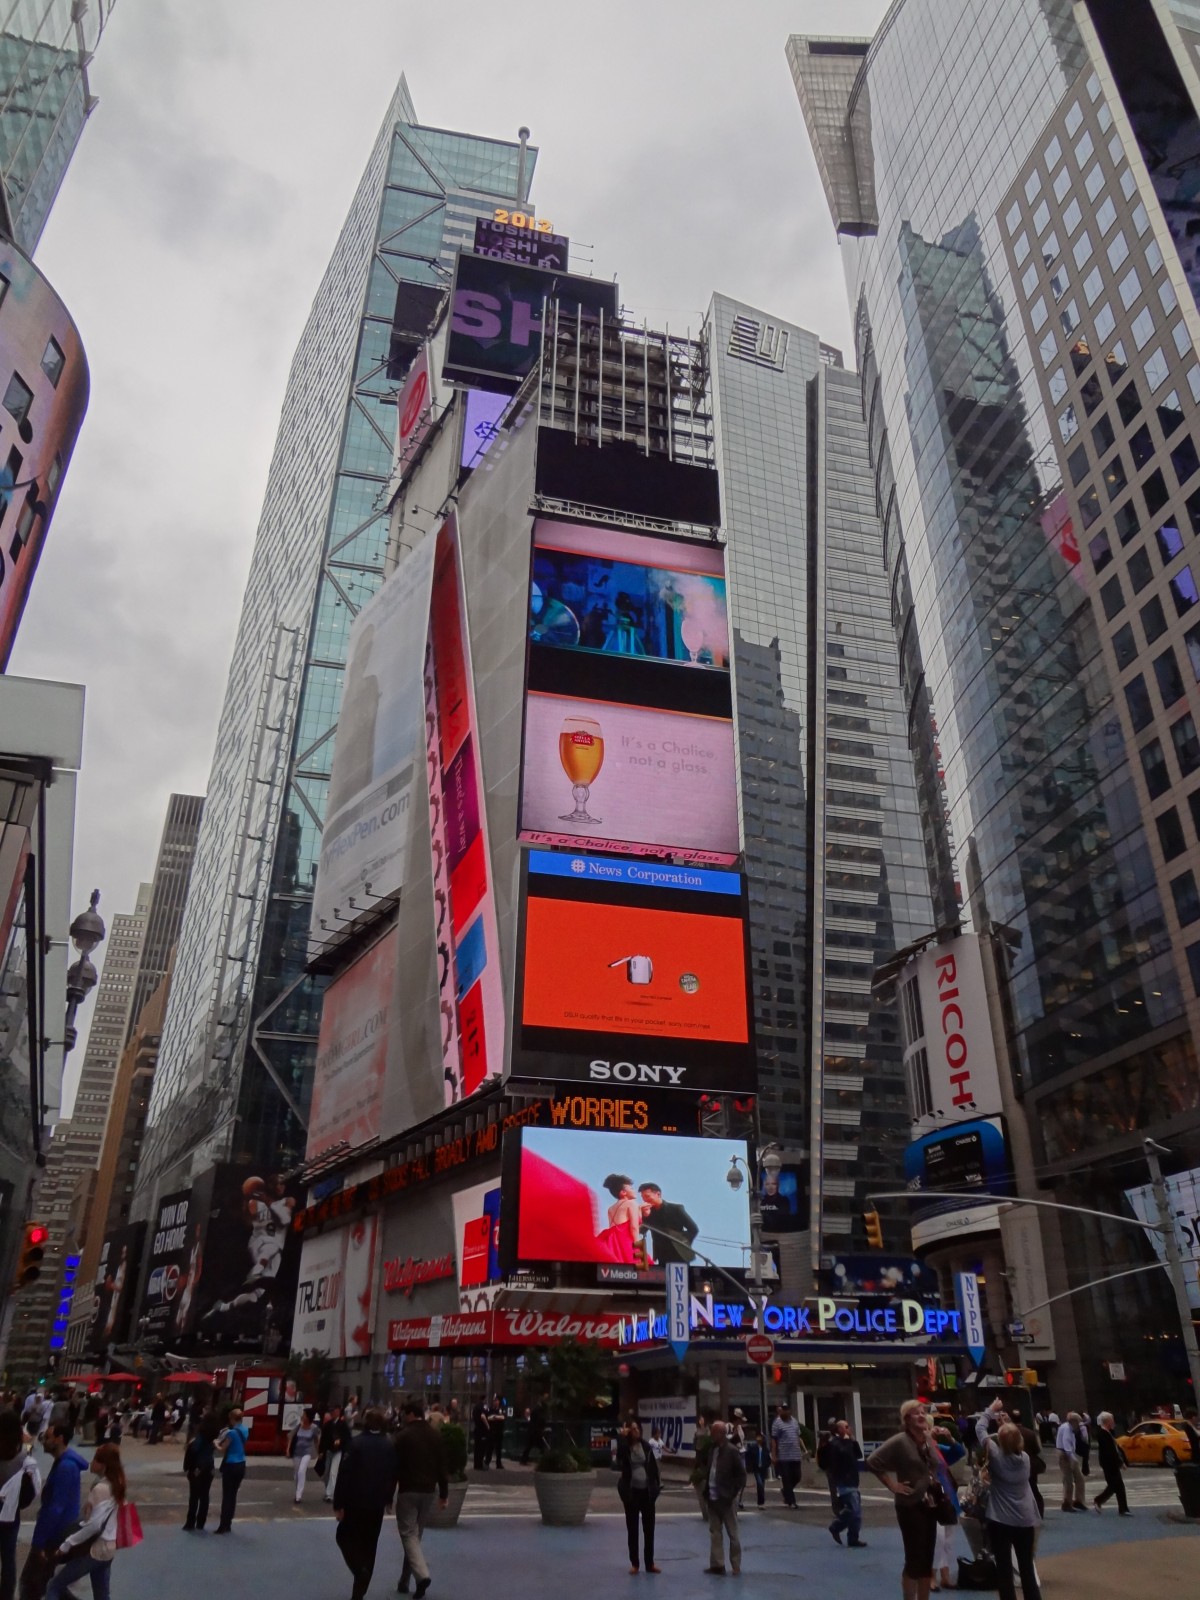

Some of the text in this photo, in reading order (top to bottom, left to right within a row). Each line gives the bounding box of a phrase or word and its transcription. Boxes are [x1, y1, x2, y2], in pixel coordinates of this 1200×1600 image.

[480, 220, 567, 247] TOSHIBA
[494, 208, 553, 234] 2012
[621, 735, 643, 750] It's
[647, 741, 656, 751] a
[629, 755, 652, 767] not
[657, 759, 666, 770] a
[530, 832, 553, 843] It's
[588, 862, 704, 886] News Corporation
[934, 952, 974, 1107] RICOH
[589, 1059, 687, 1084] SONY
[550, 1096, 649, 1130] WORRIES
[160, 1200, 189, 1229] WIN OR
[153, 1226, 188, 1255] GO HOME
[383, 1252, 455, 1297] Walgreens
[610, 1269, 638, 1280] Media
[674, 1266, 685, 1338] NYPD
[690, 1294, 746, 1330] NEW
[818, 1298, 897, 1334] POLICE
[902, 1299, 962, 1334] DEPT
[964, 1275, 981, 1344] NYPD
[441, 1315, 487, 1344] Walgreens
